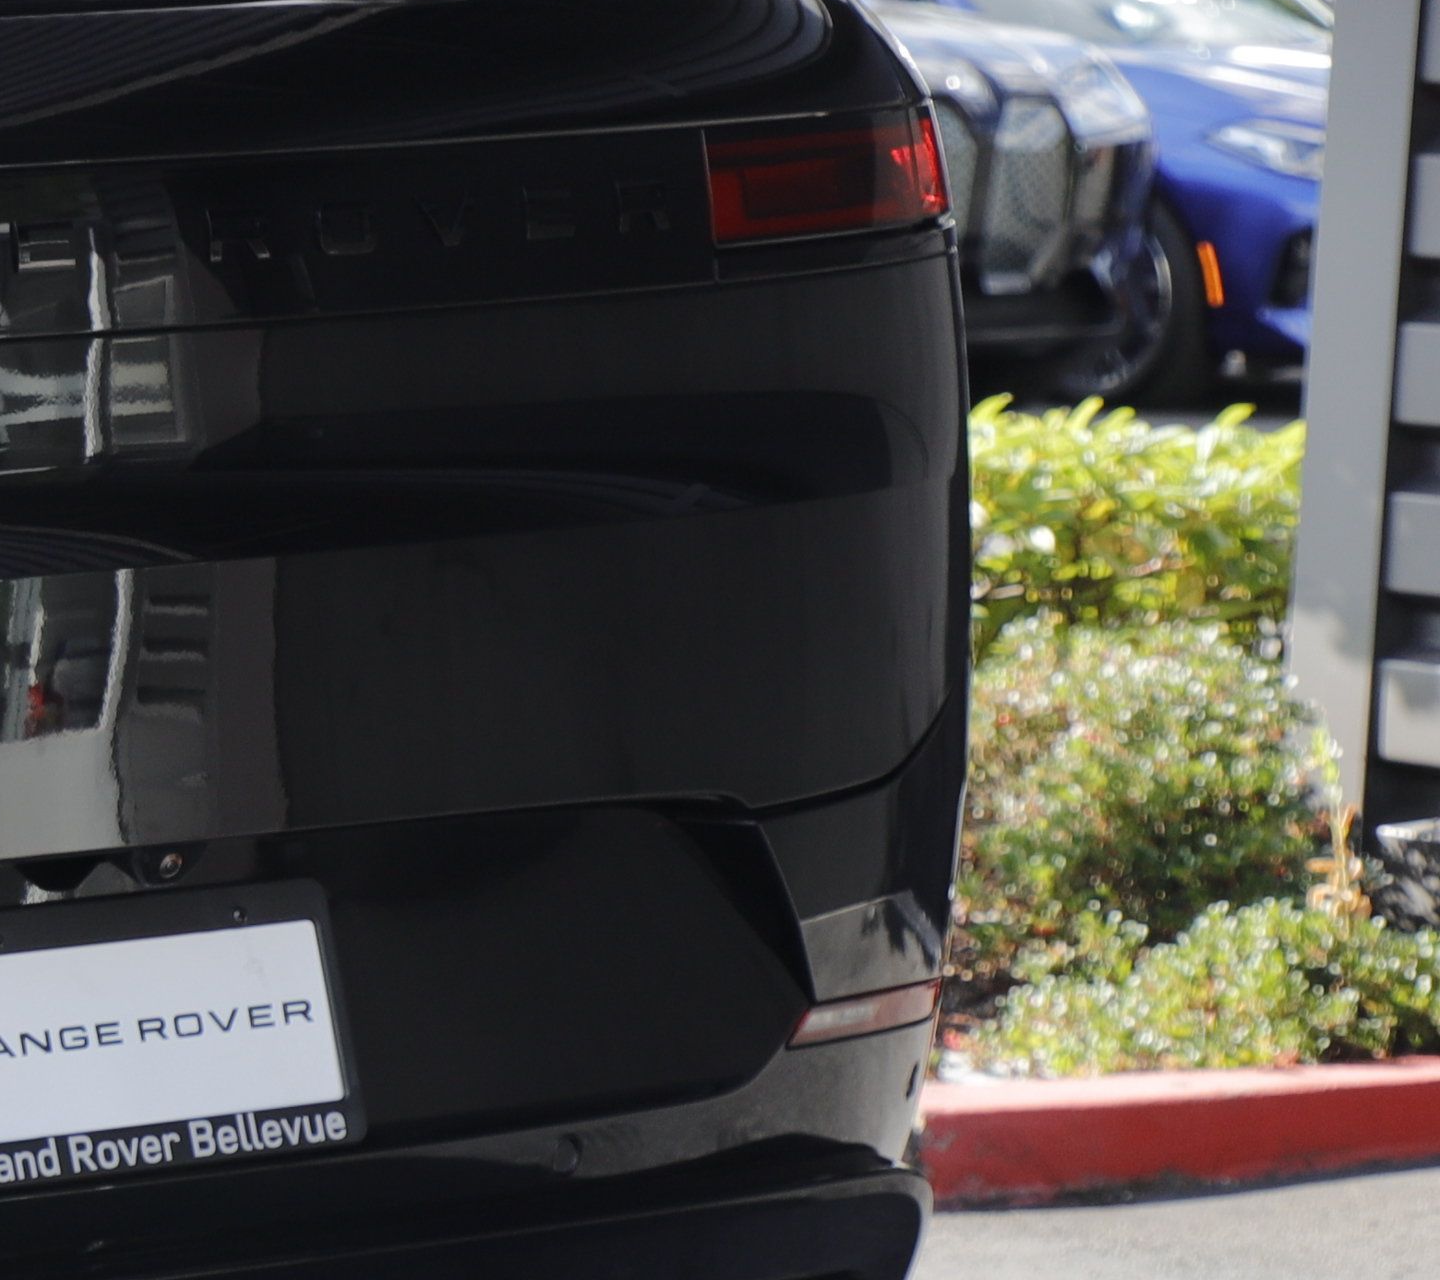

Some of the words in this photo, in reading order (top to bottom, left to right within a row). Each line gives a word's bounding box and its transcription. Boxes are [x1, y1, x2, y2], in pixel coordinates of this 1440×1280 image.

[203, 179, 673, 264] ROVER
[137, 999, 314, 1042] ROVER
[66, 1130, 182, 1176] Rover
[187, 1110, 349, 1160] Bellevue
